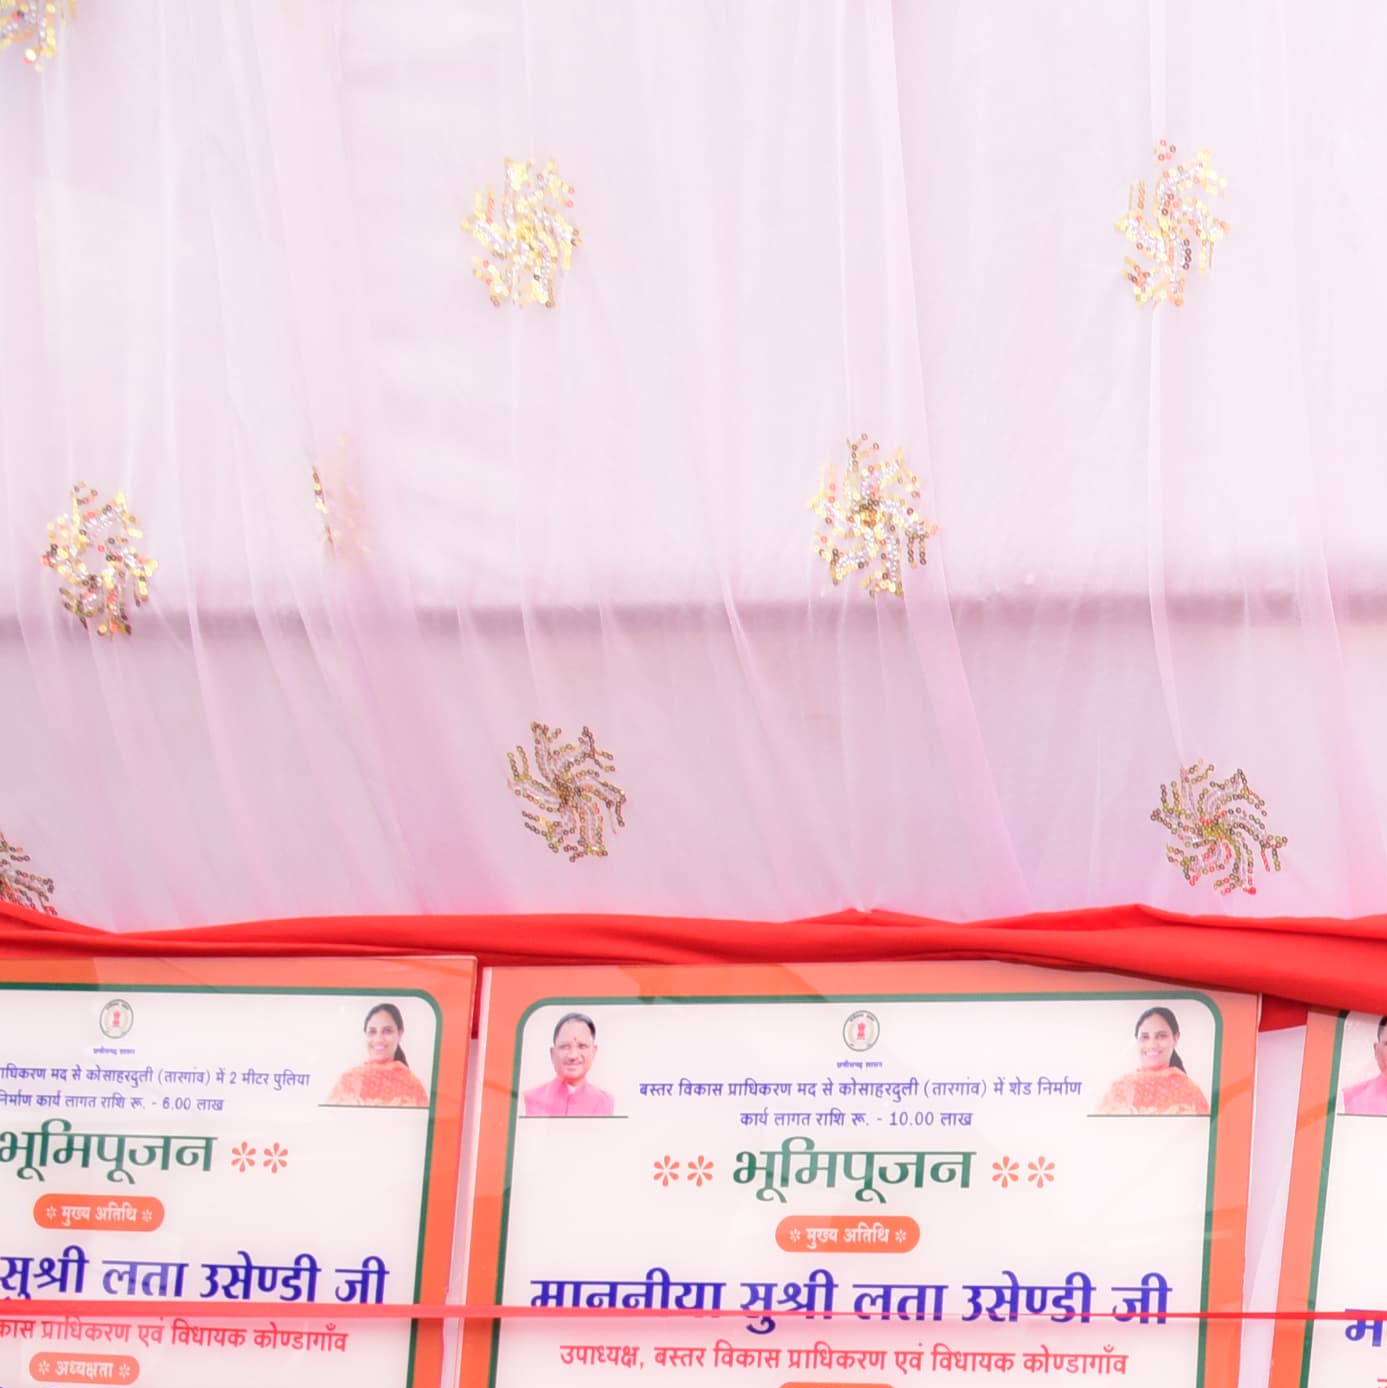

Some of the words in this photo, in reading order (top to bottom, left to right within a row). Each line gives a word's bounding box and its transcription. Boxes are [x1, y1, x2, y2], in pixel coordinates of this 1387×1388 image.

[86, 1064, 153, 1088] कोसाहरदुली
[273, 1068, 310, 1091] पुलिया
[838, 1077, 919, 1103] कोसाहरदुली
[0, 1118, 218, 1184] भूमिपूजन
[733, 1136, 976, 1204] भूमिपूजन
[102, 1259, 189, 1297] लता
[200, 1250, 321, 1302] उसेण्डी
[335, 1255, 390, 1304] जी
[41, 1315, 131, 1343] प्राधिकरण
[138, 1317, 164, 1346] एवं
[171, 1318, 246, 1348] विधायक
[253, 1321, 349, 1352] कोण्डागाँव
